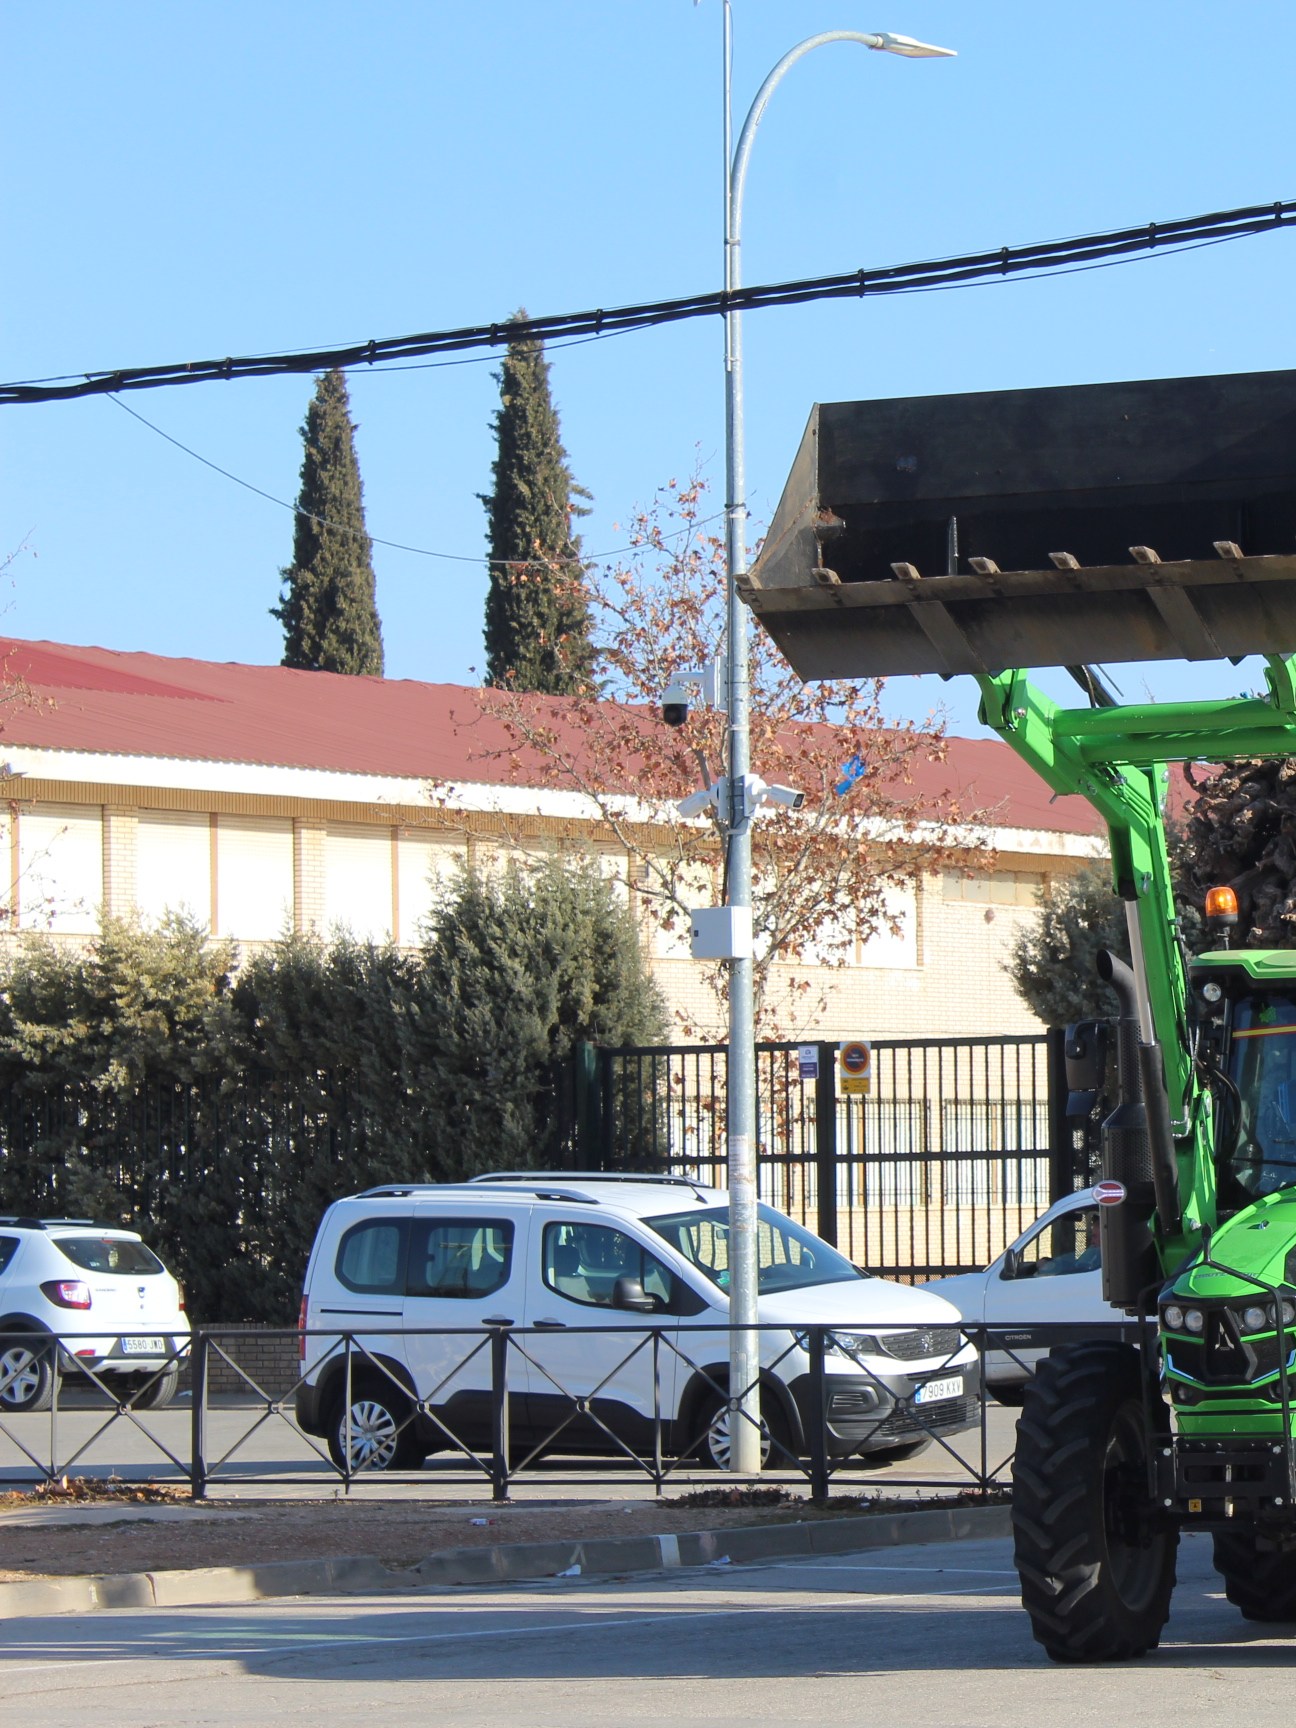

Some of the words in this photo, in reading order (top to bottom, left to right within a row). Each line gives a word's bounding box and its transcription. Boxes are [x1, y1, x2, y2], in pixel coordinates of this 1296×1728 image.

[127, 1339, 147, 1350] 5580
[922, 1383, 944, 1400] 7909
[946, 1380, 961, 1395] KXV
